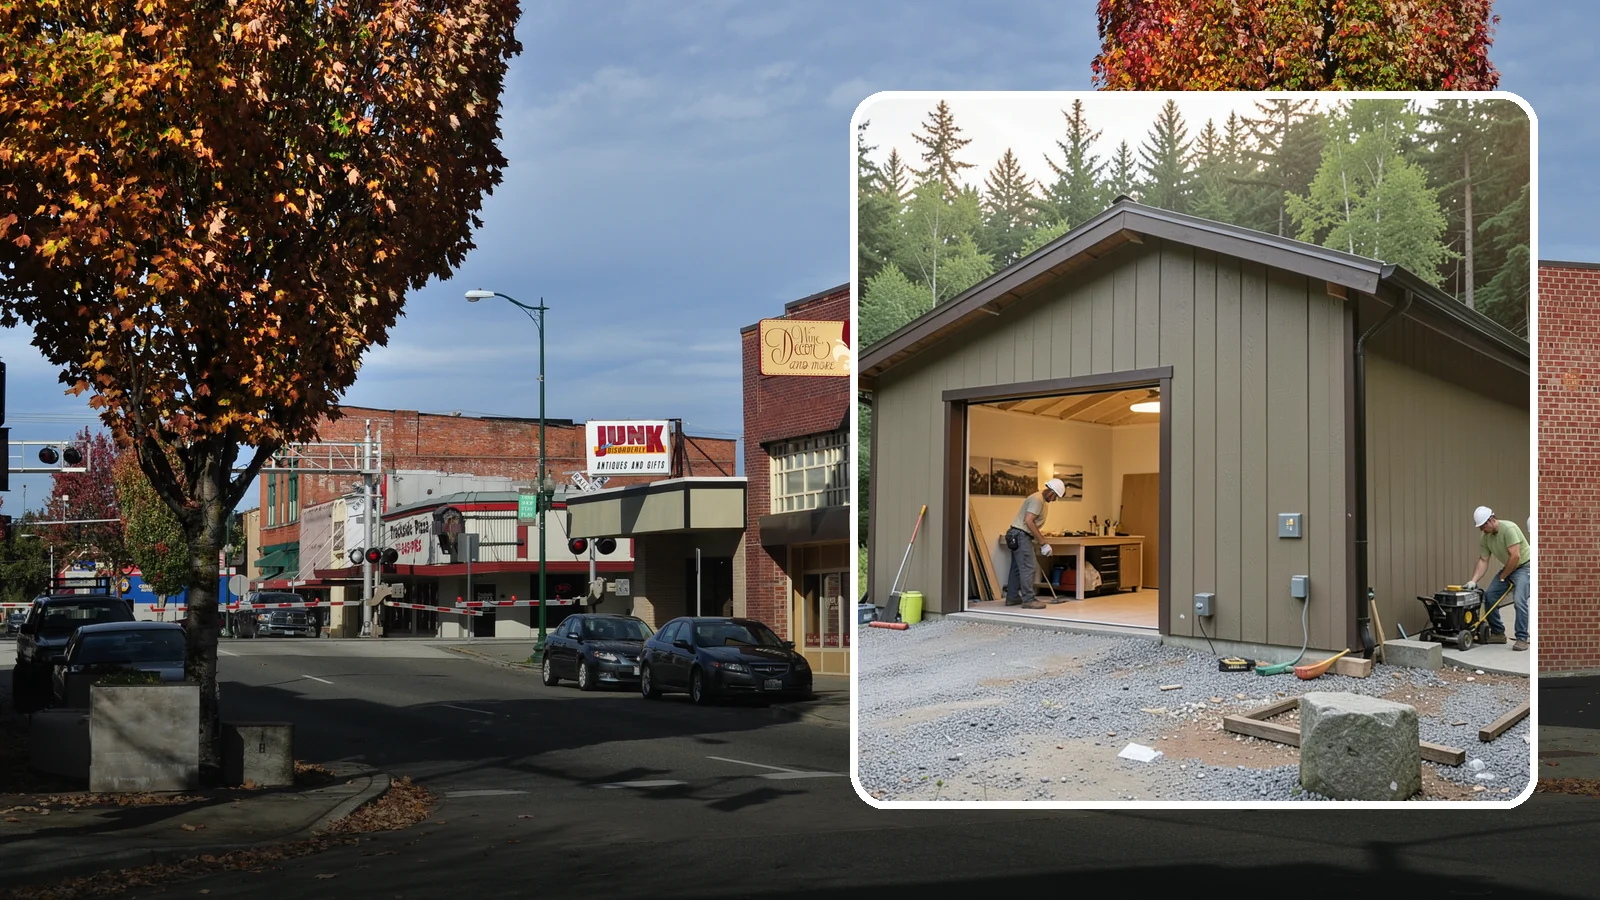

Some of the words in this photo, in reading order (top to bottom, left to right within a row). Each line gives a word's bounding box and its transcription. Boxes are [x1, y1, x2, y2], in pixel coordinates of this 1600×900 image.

[765, 327, 831, 365] Decor
[596, 425, 665, 457] JUNK
[607, 446, 646, 454] DISORDERLY
[596, 460, 628, 470] ANTIQUES
[631, 460, 644, 470] AND
[647, 460, 665, 470] GIFTS
[390, 522, 412, 539] Trackside
[415, 519, 429, 534] Pizza
